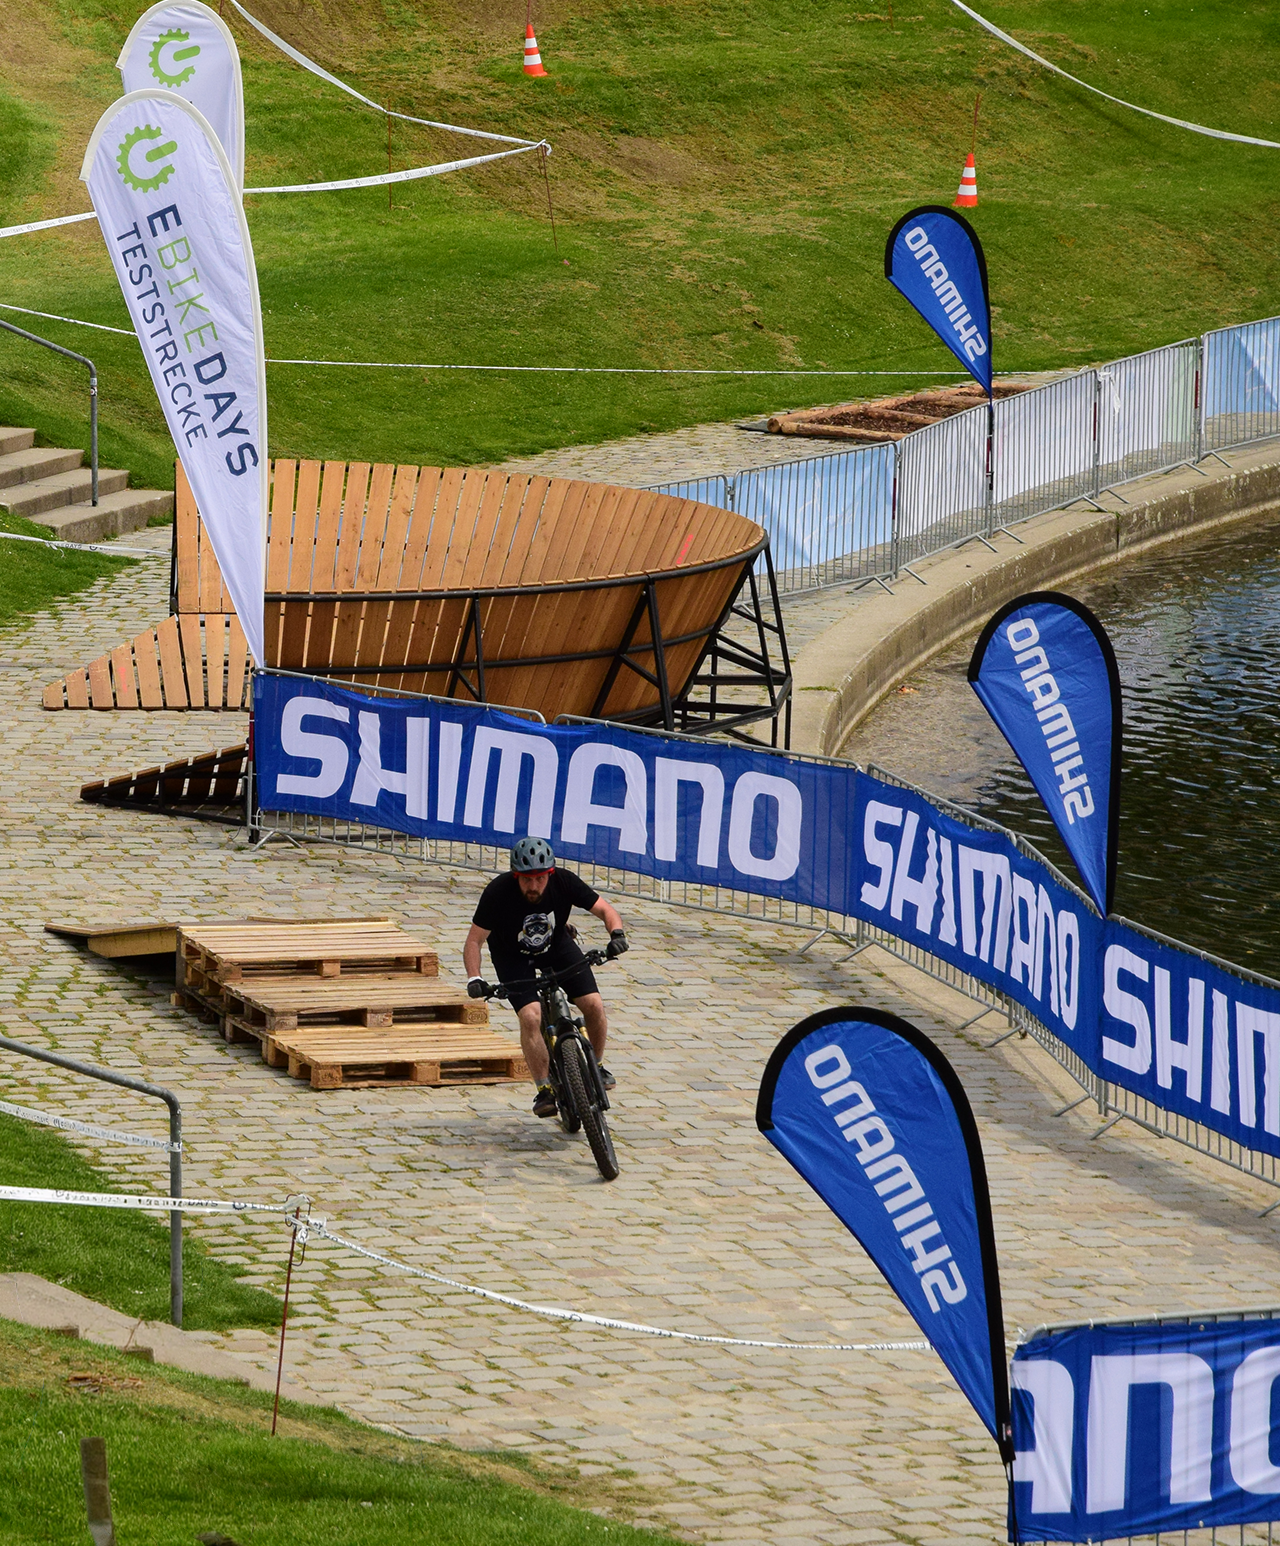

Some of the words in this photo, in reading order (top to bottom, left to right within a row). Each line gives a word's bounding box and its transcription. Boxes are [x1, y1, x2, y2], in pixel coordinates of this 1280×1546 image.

[116, 221, 208, 448] TESTSTRECKE
[276, 696, 802, 881] SHIMANO
[860, 799, 1080, 1030] SHIMANO
